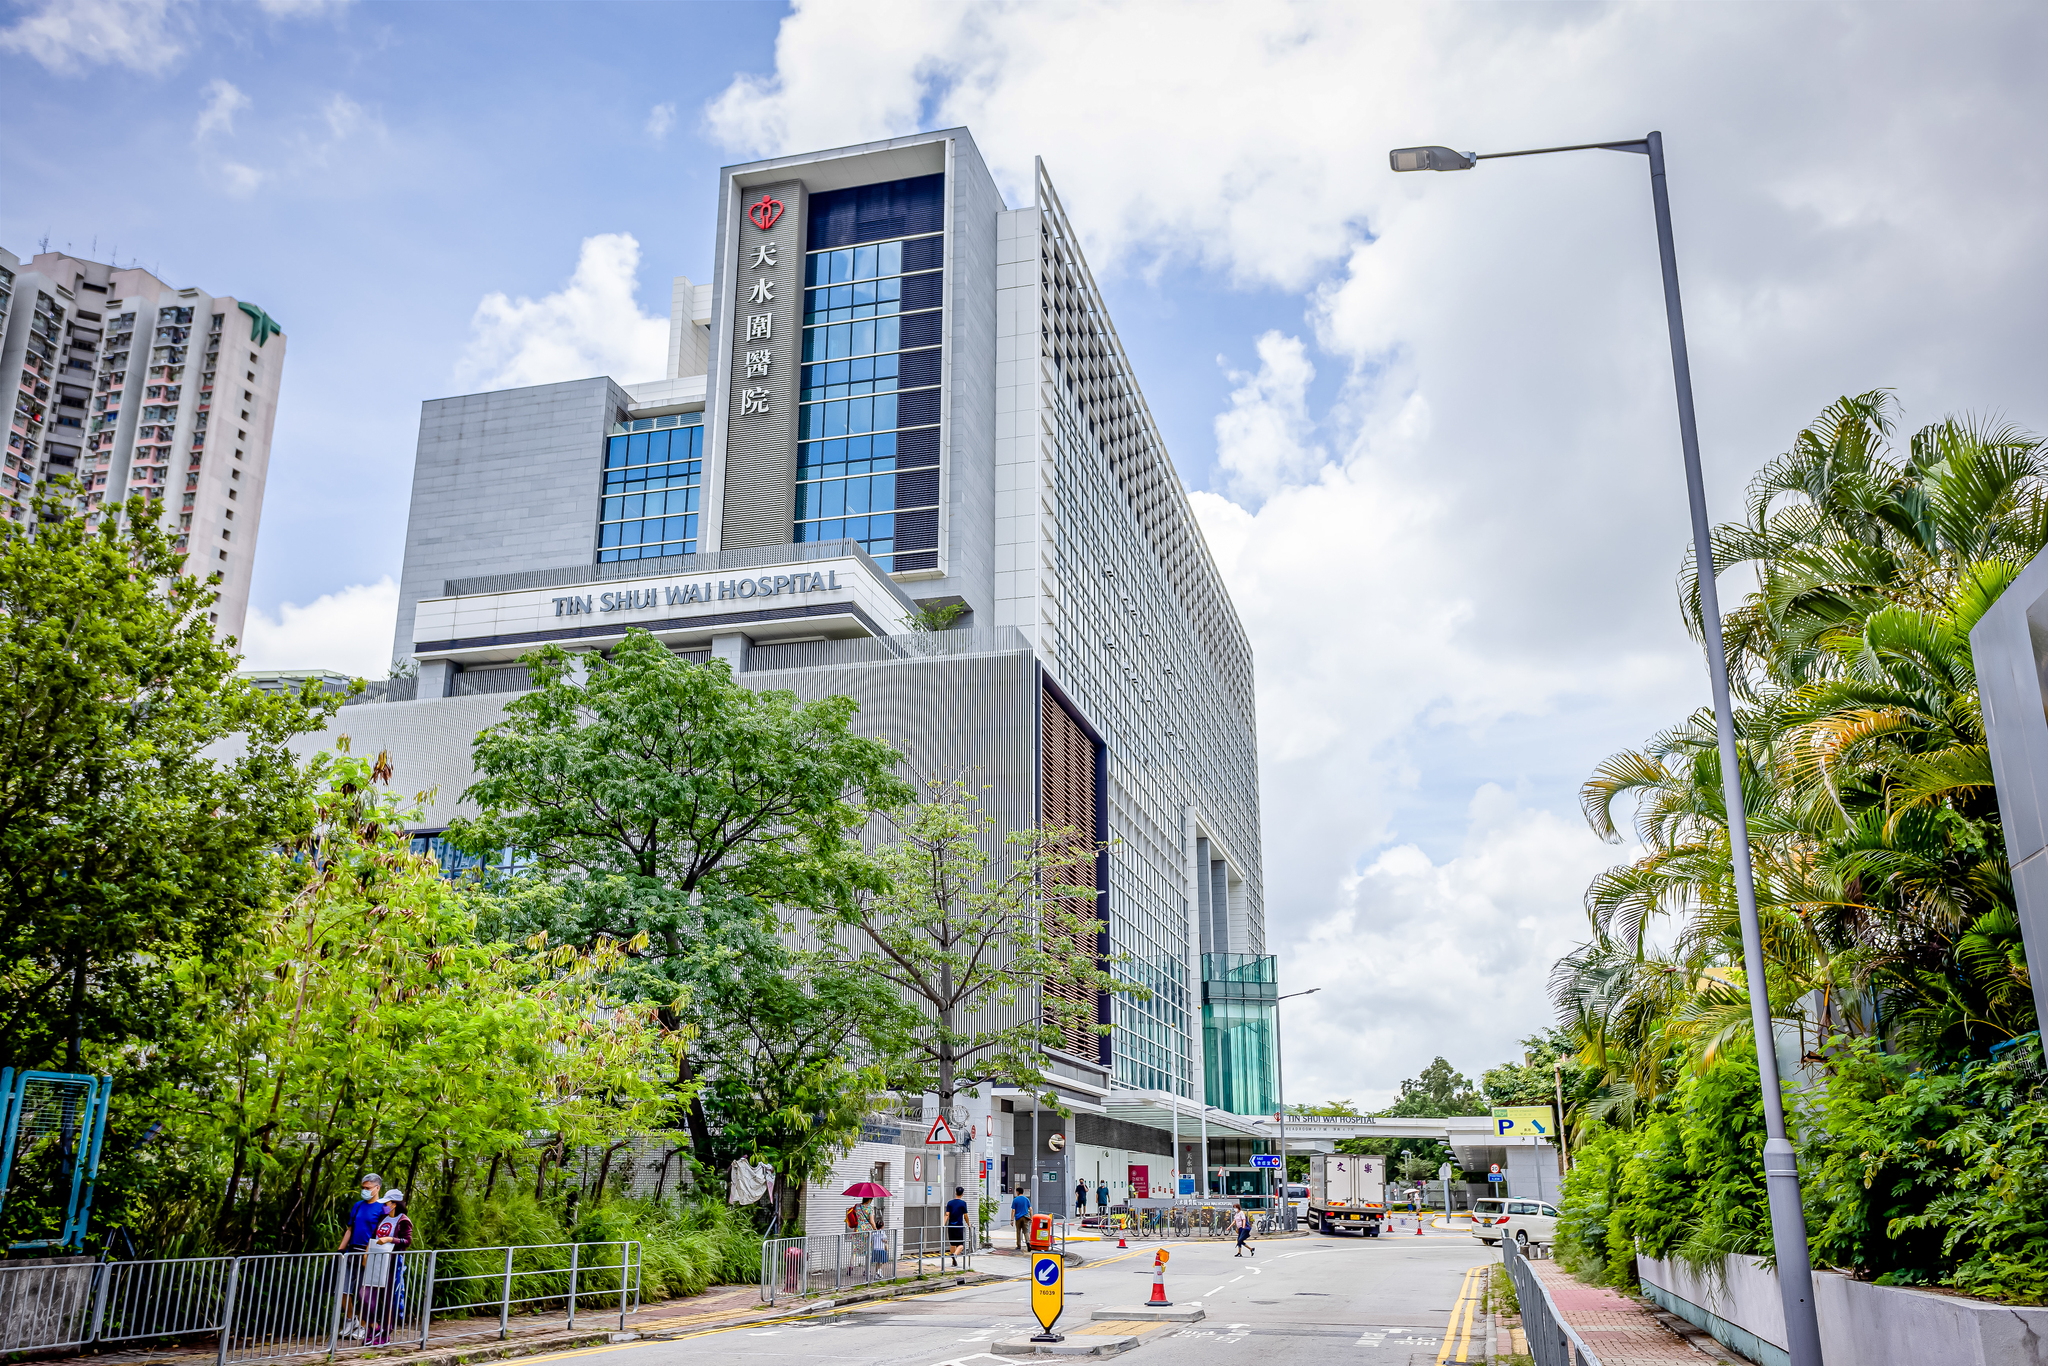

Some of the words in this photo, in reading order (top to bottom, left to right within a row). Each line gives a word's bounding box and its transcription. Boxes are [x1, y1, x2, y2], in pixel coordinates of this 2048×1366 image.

[741, 242, 777, 416] 天水圍醫院
[551, 595, 592, 617] TIN
[600, 588, 657, 612] SHUI
[665, 582, 711, 605] WAI
[718, 570, 842, 600] HOSPITAL
[1498, 1119, 1514, 1135] P
